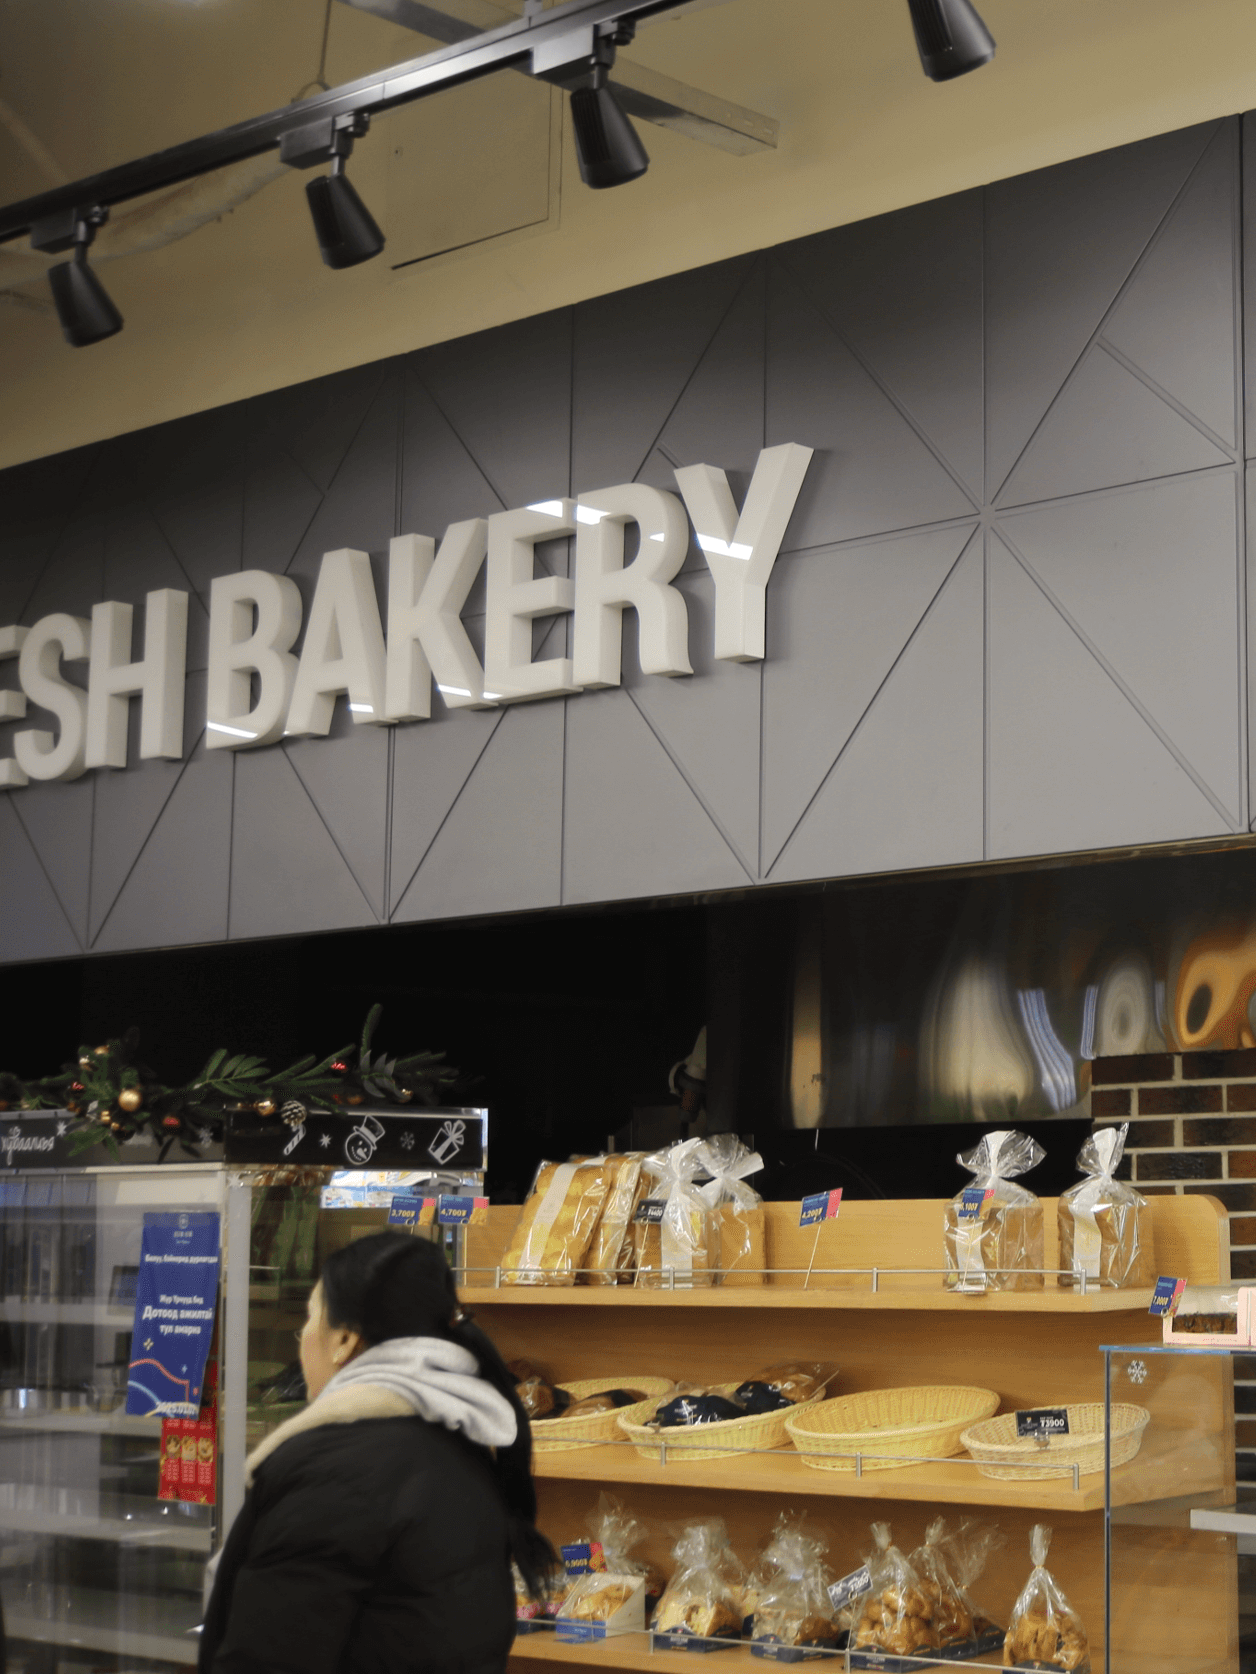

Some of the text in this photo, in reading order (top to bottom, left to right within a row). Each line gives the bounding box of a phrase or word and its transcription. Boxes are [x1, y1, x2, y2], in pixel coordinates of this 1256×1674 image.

[206, 443, 815, 750] BAKERY
[142, 1304, 179, 1321] Дотоод
[1039, 1418, 1065, 1428] ₮3900
